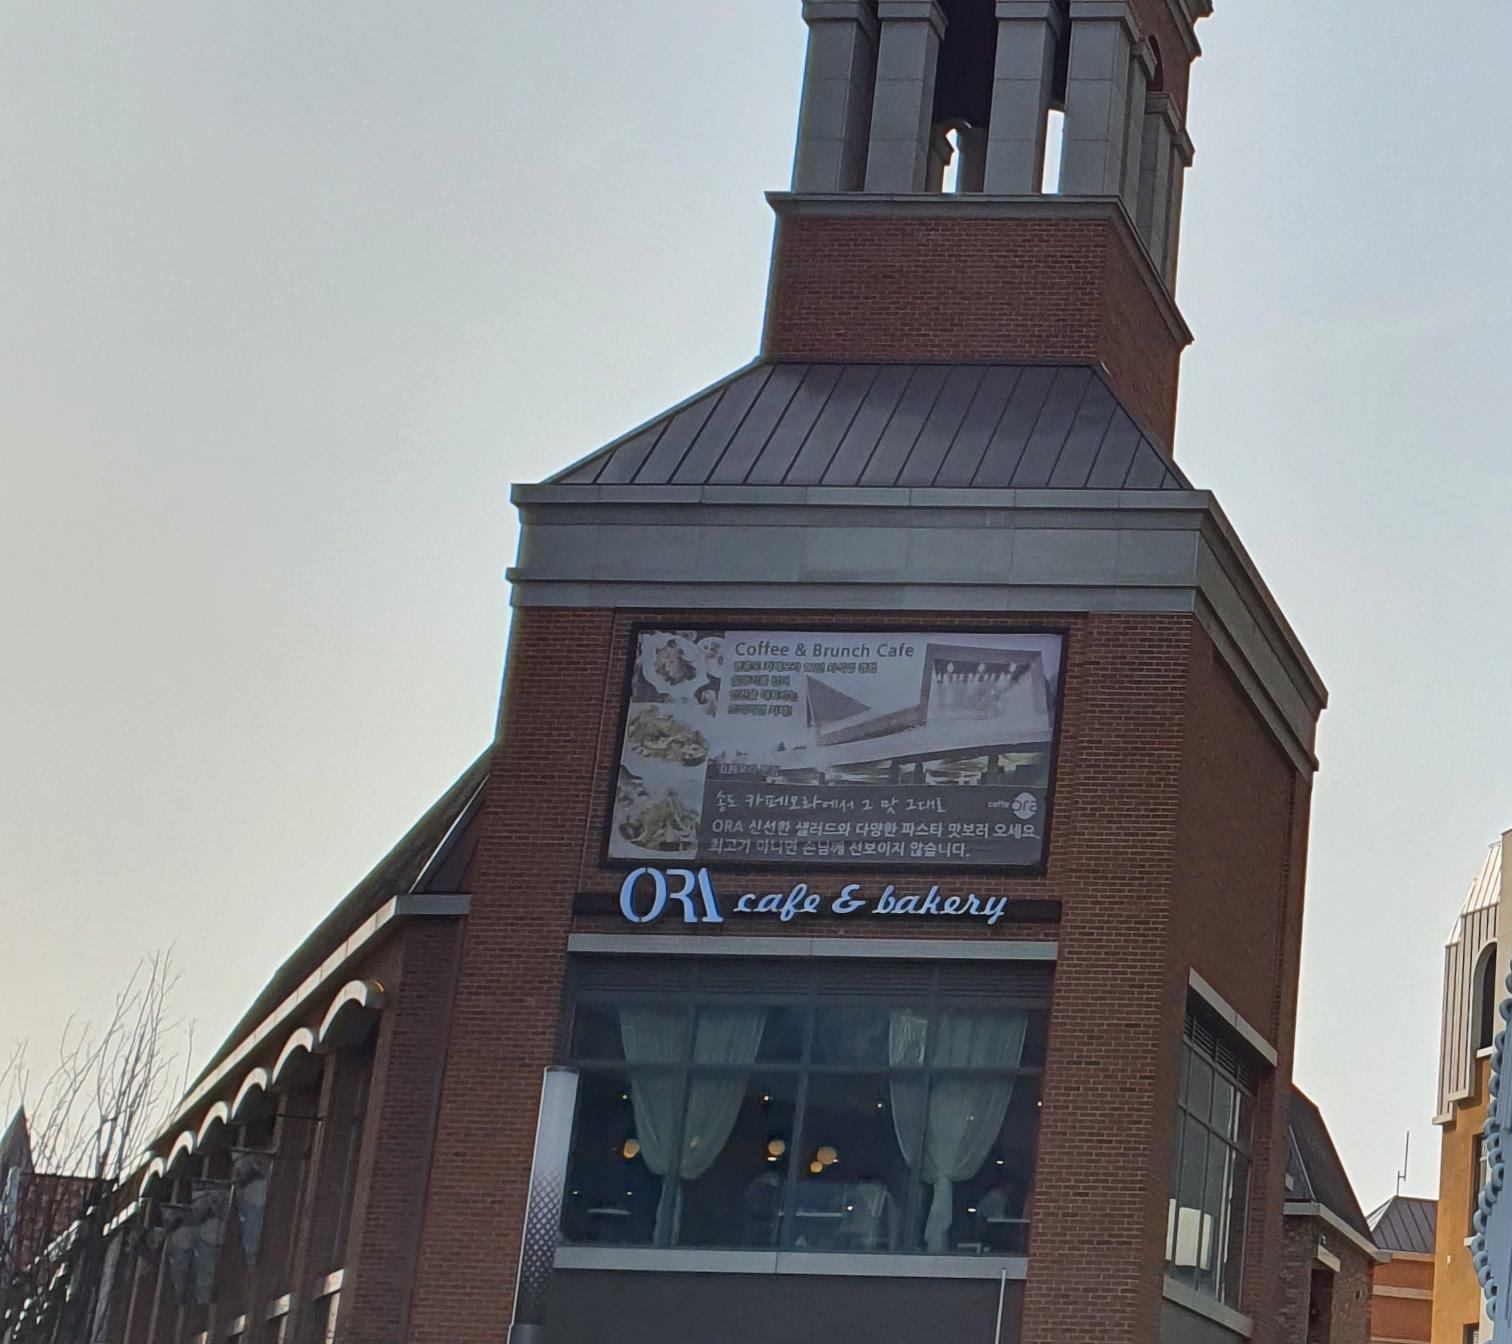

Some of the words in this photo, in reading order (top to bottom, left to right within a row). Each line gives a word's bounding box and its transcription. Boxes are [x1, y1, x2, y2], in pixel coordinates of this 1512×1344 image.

[735, 640, 790, 657] Coffee
[795, 643, 807, 657] &
[813, 642, 870, 658] Brunch
[876, 642, 915, 658] Cafe
[880, 796, 900, 815] 맛
[712, 818, 744, 834] ORA
[749, 818, 791, 836] 신선한
[855, 821, 898, 838] 다양한
[901, 822, 944, 839] 파스타
[948, 823, 989, 839] 맛보러
[849, 840, 905, 857] 선보이지
[619, 866, 724, 924] ORA
[733, 882, 821, 922] cafe
[831, 883, 866, 915] &
[871, 884, 1008, 925] bakery
